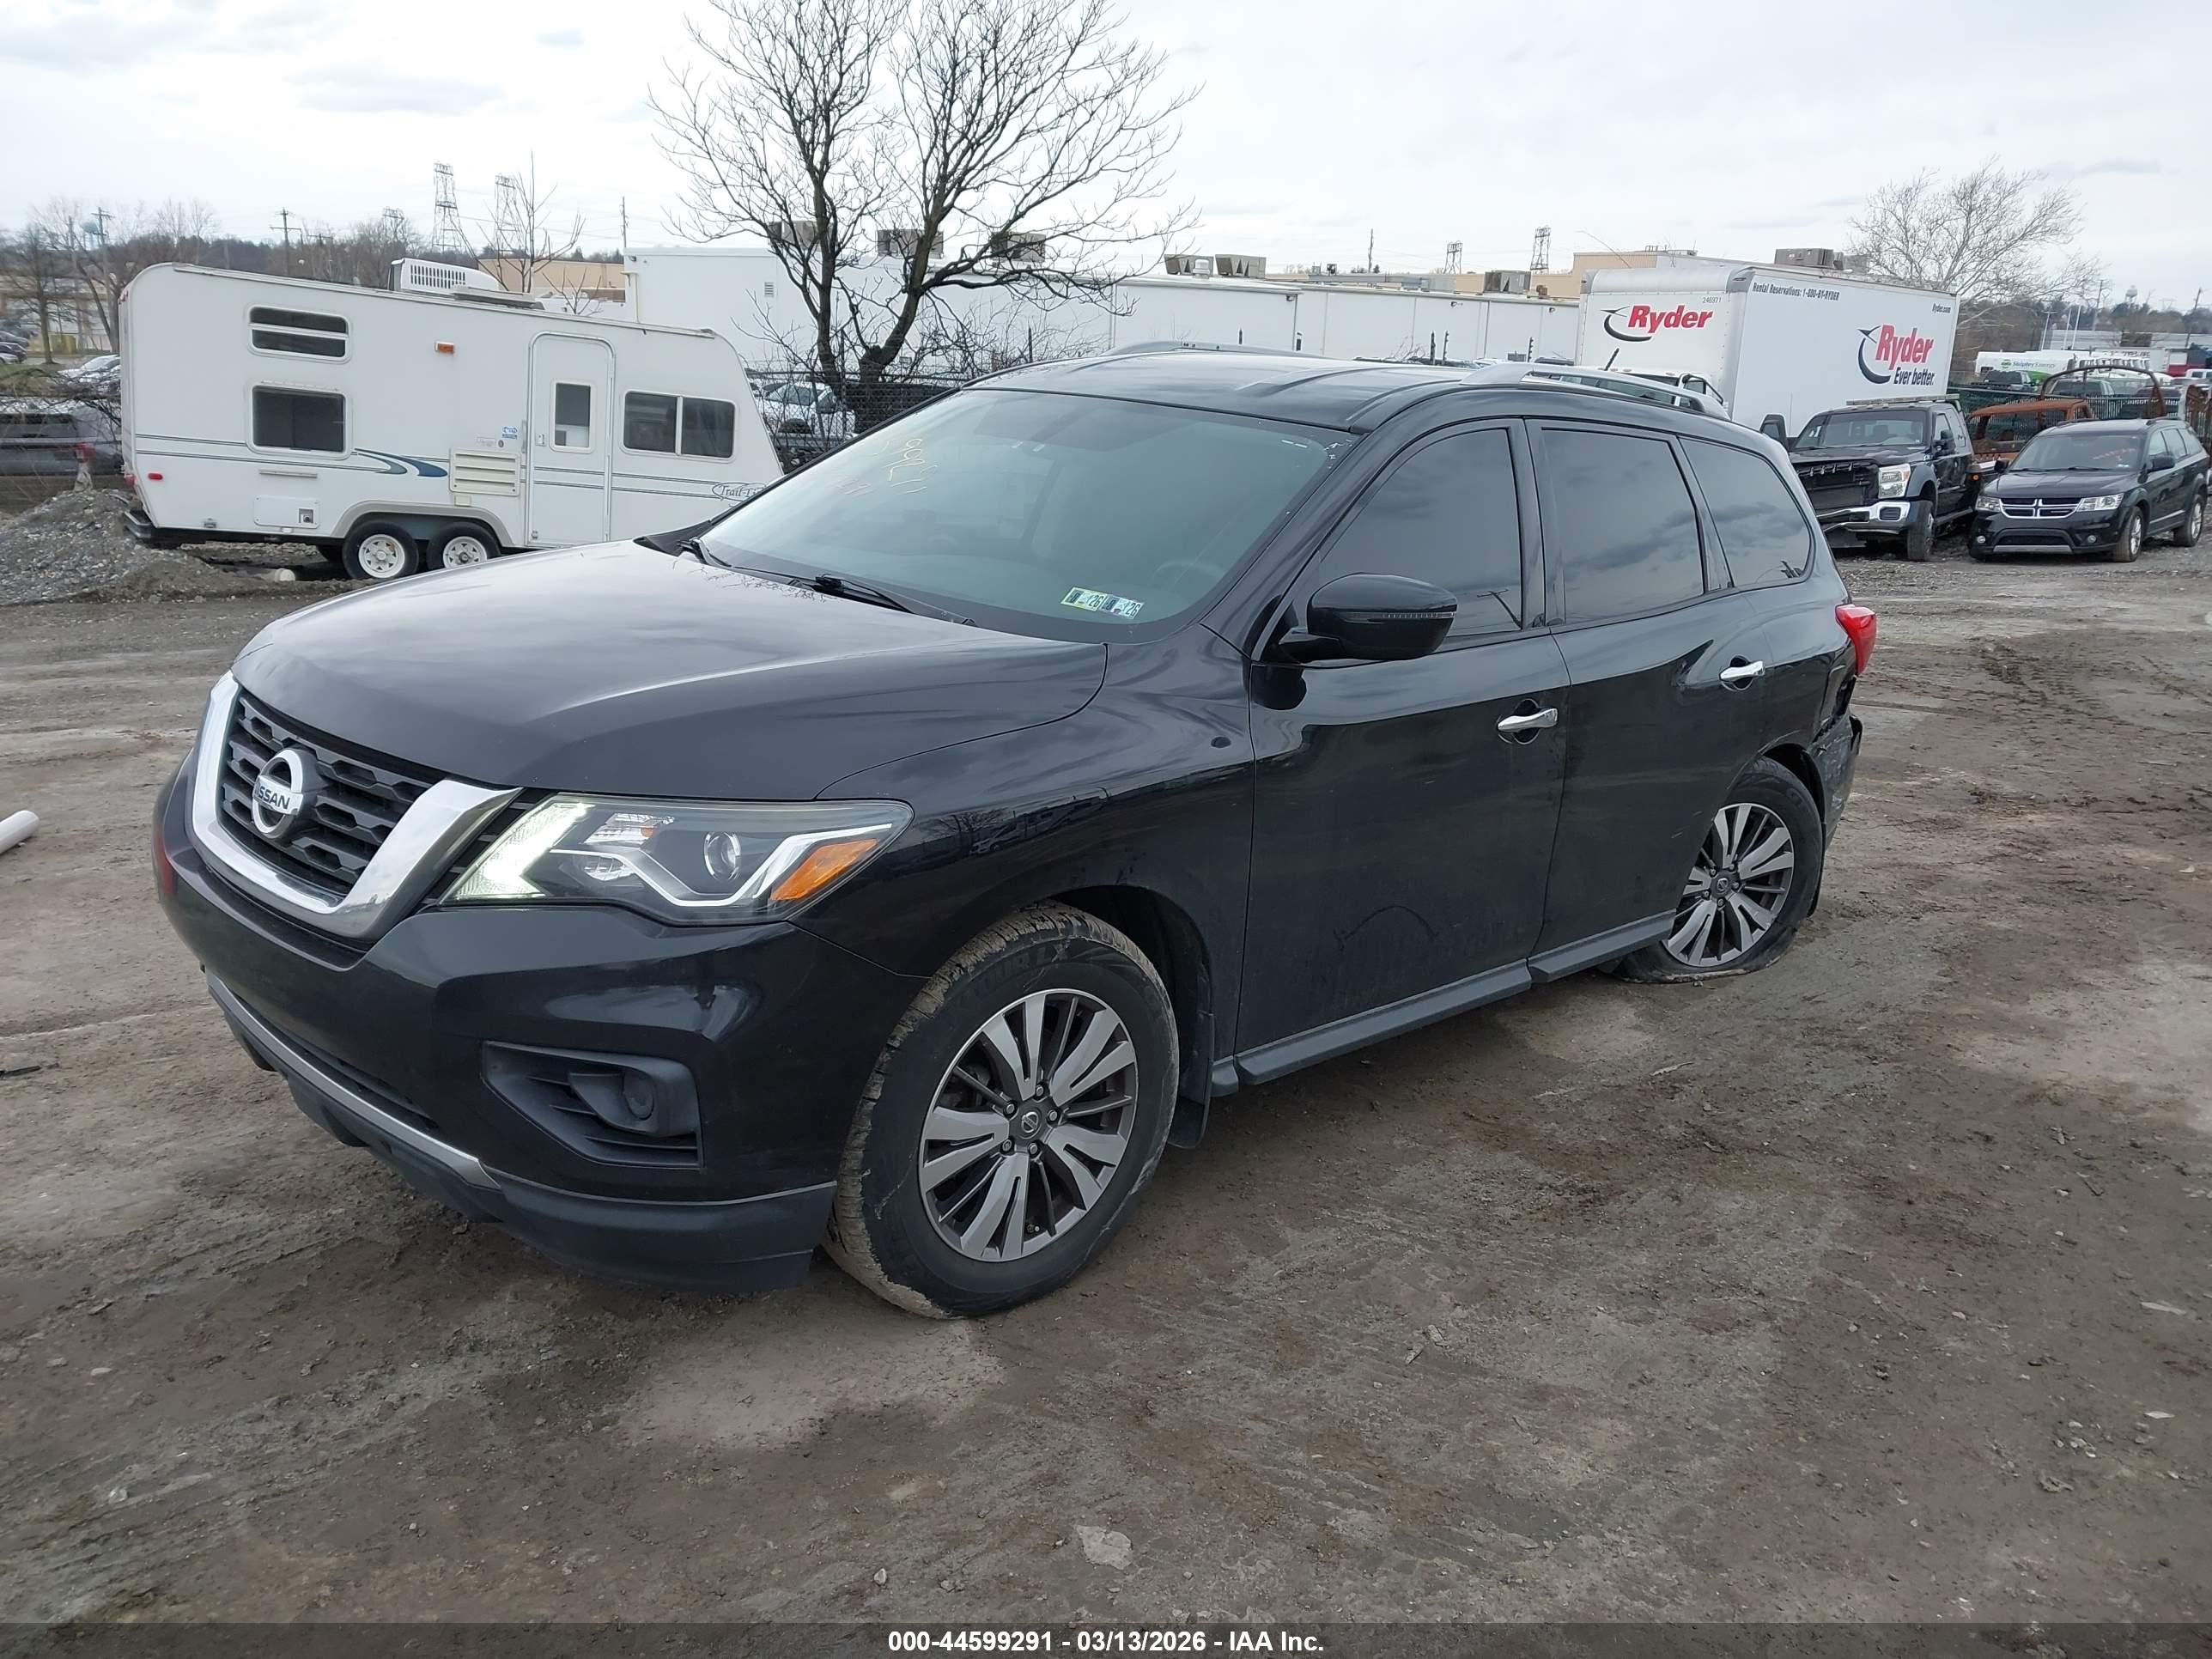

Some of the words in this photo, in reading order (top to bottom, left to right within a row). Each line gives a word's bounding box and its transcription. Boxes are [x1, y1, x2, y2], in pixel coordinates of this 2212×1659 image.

[1752, 282, 1769, 293] Rental
[1769, 283, 1802, 297] Reservations:
[1627, 304, 1714, 334] Ryder
[1875, 324, 1935, 371] Ryder
[1893, 366, 1911, 385] Ever
[1911, 368, 1936, 386] better.
[254, 782, 290, 810] SSAN
